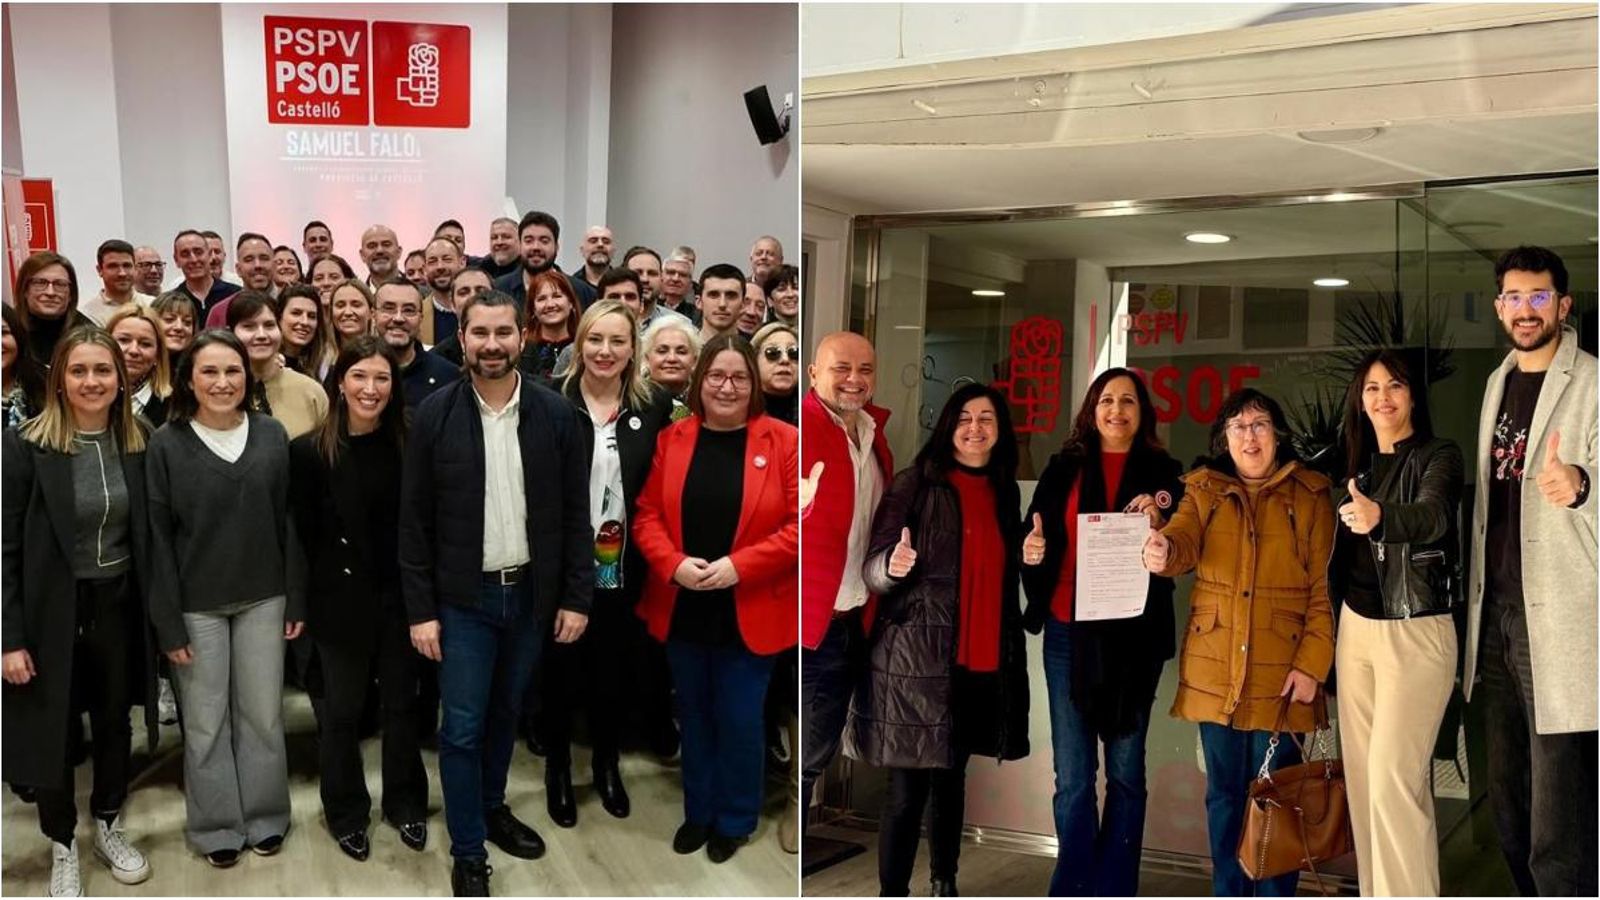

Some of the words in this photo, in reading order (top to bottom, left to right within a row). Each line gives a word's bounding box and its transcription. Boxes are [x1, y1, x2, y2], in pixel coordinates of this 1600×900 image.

[273, 27, 361, 58] PSPV
[275, 61, 361, 96] PSOE
[277, 100, 340, 119] Castelló
[286, 130, 365, 156] SAMUEL
[369, 132, 421, 157] FALO
[1117, 311, 1189, 347] PSPV
